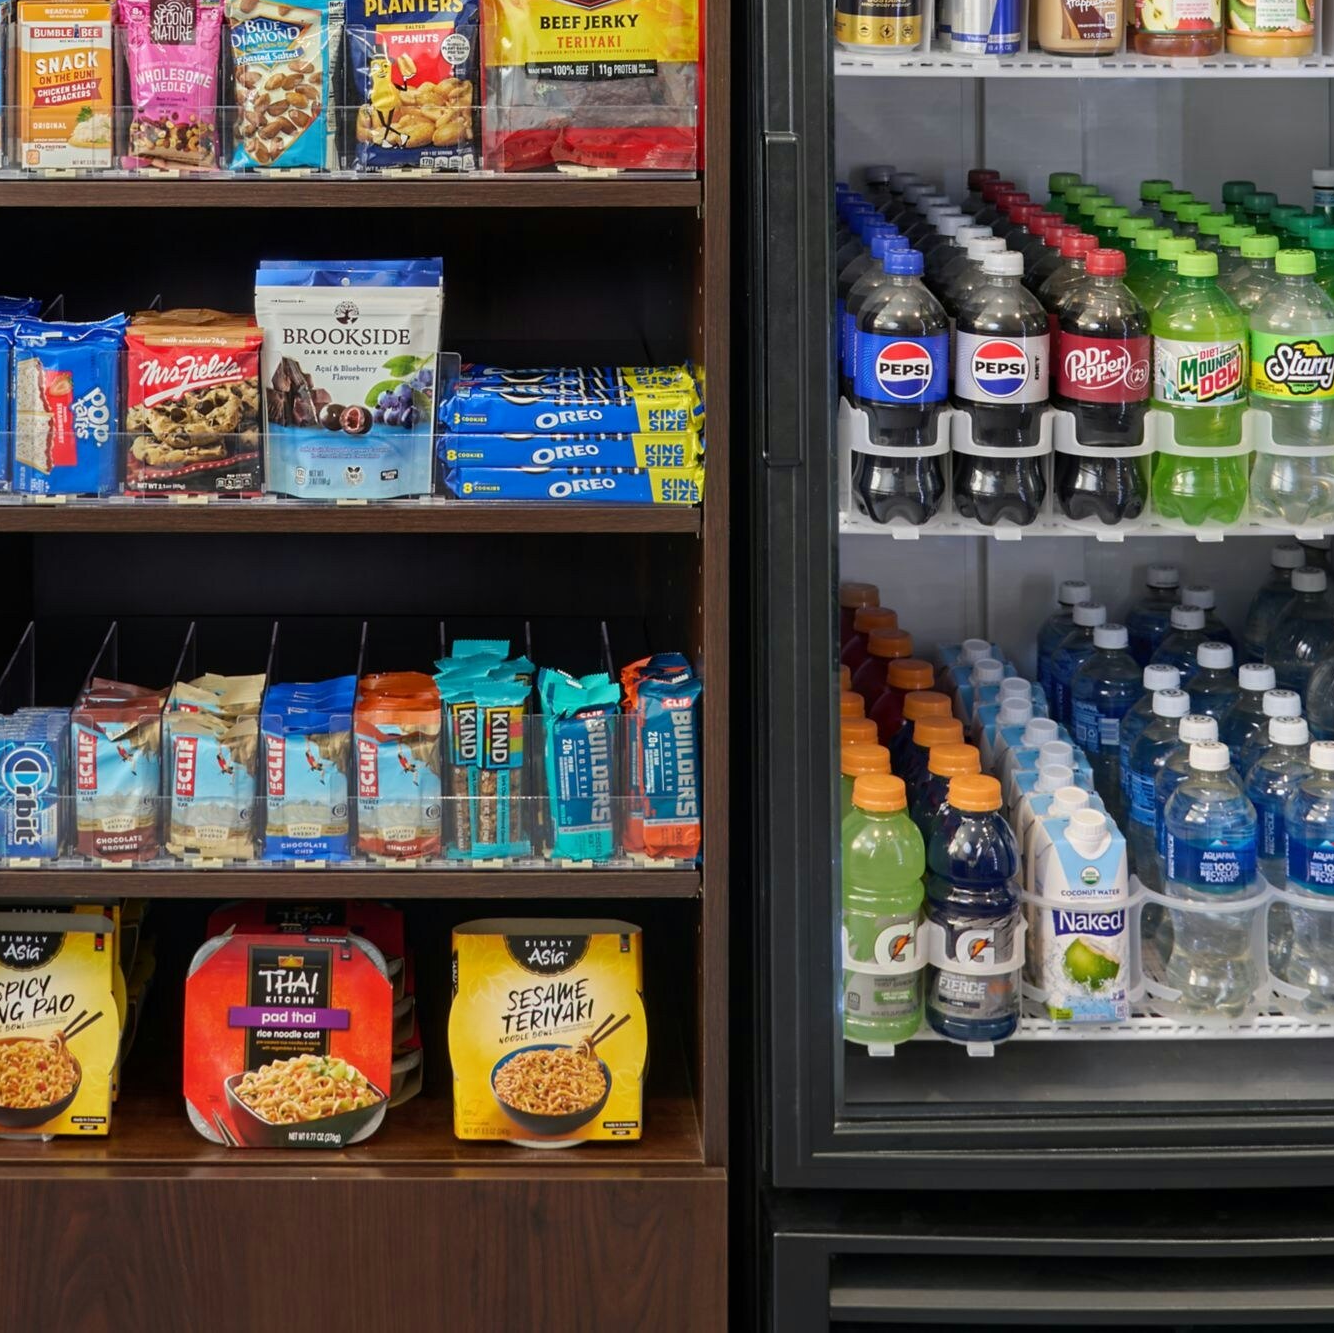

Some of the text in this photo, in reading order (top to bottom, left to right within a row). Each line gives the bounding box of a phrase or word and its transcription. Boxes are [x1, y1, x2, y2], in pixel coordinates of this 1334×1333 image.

[154, 14, 192, 27] SECOND
[245, 22, 280, 33] BLUE
[540, 15, 638, 30] BEEF JERKY
[154, 28, 192, 40] NATURE
[231, 31, 300, 48] DIAMOND
[391, 33, 439, 44] PEANUTS
[557, 36, 621, 48] TERIYAKI
[236, 49, 299, 64] Roasted Salted
[599, 65, 637, 76] 11g PROTEIN
[136, 72, 212, 90] WHOLESOME
[151, 82, 193, 94] MEDLEY
[283, 329, 411, 346] BROOKSIDE
[1085, 347, 1110, 366] Dr
[139, 357, 181, 386] Mrs.
[341, 365, 377, 374] Blueberry
[879, 362, 929, 376] PEPSI
[975, 361, 1026, 375] PEPSI
[1069, 350, 1127, 383] Pepper
[332, 373, 360, 381] Flavors
[535, 409, 603, 430] OREO
[648, 409, 687, 421] KING
[649, 420, 687, 431] SIZE
[491, 712, 508, 764] KIND
[77, 729, 98, 776] CLIF
[671, 712, 696, 817] BUILDERS
[96, 836, 142, 845] CHOCOLATE
[1059, 909, 1122, 931] Naked
[1, 935, 48, 943] SIMPLY
[3, 945, 40, 961] Asia
[258, 970, 319, 995] THAI
[266, 996, 314, 1004] KITCHEN
[508, 979, 588, 1011] SESAME
[33, 995, 74, 1019] PAO
[261, 1012, 316, 1024] pad thai
[502, 999, 593, 1033] TERIYAKI
[257, 1030, 272, 1038] rice
[274, 1030, 301, 1038] noodle
